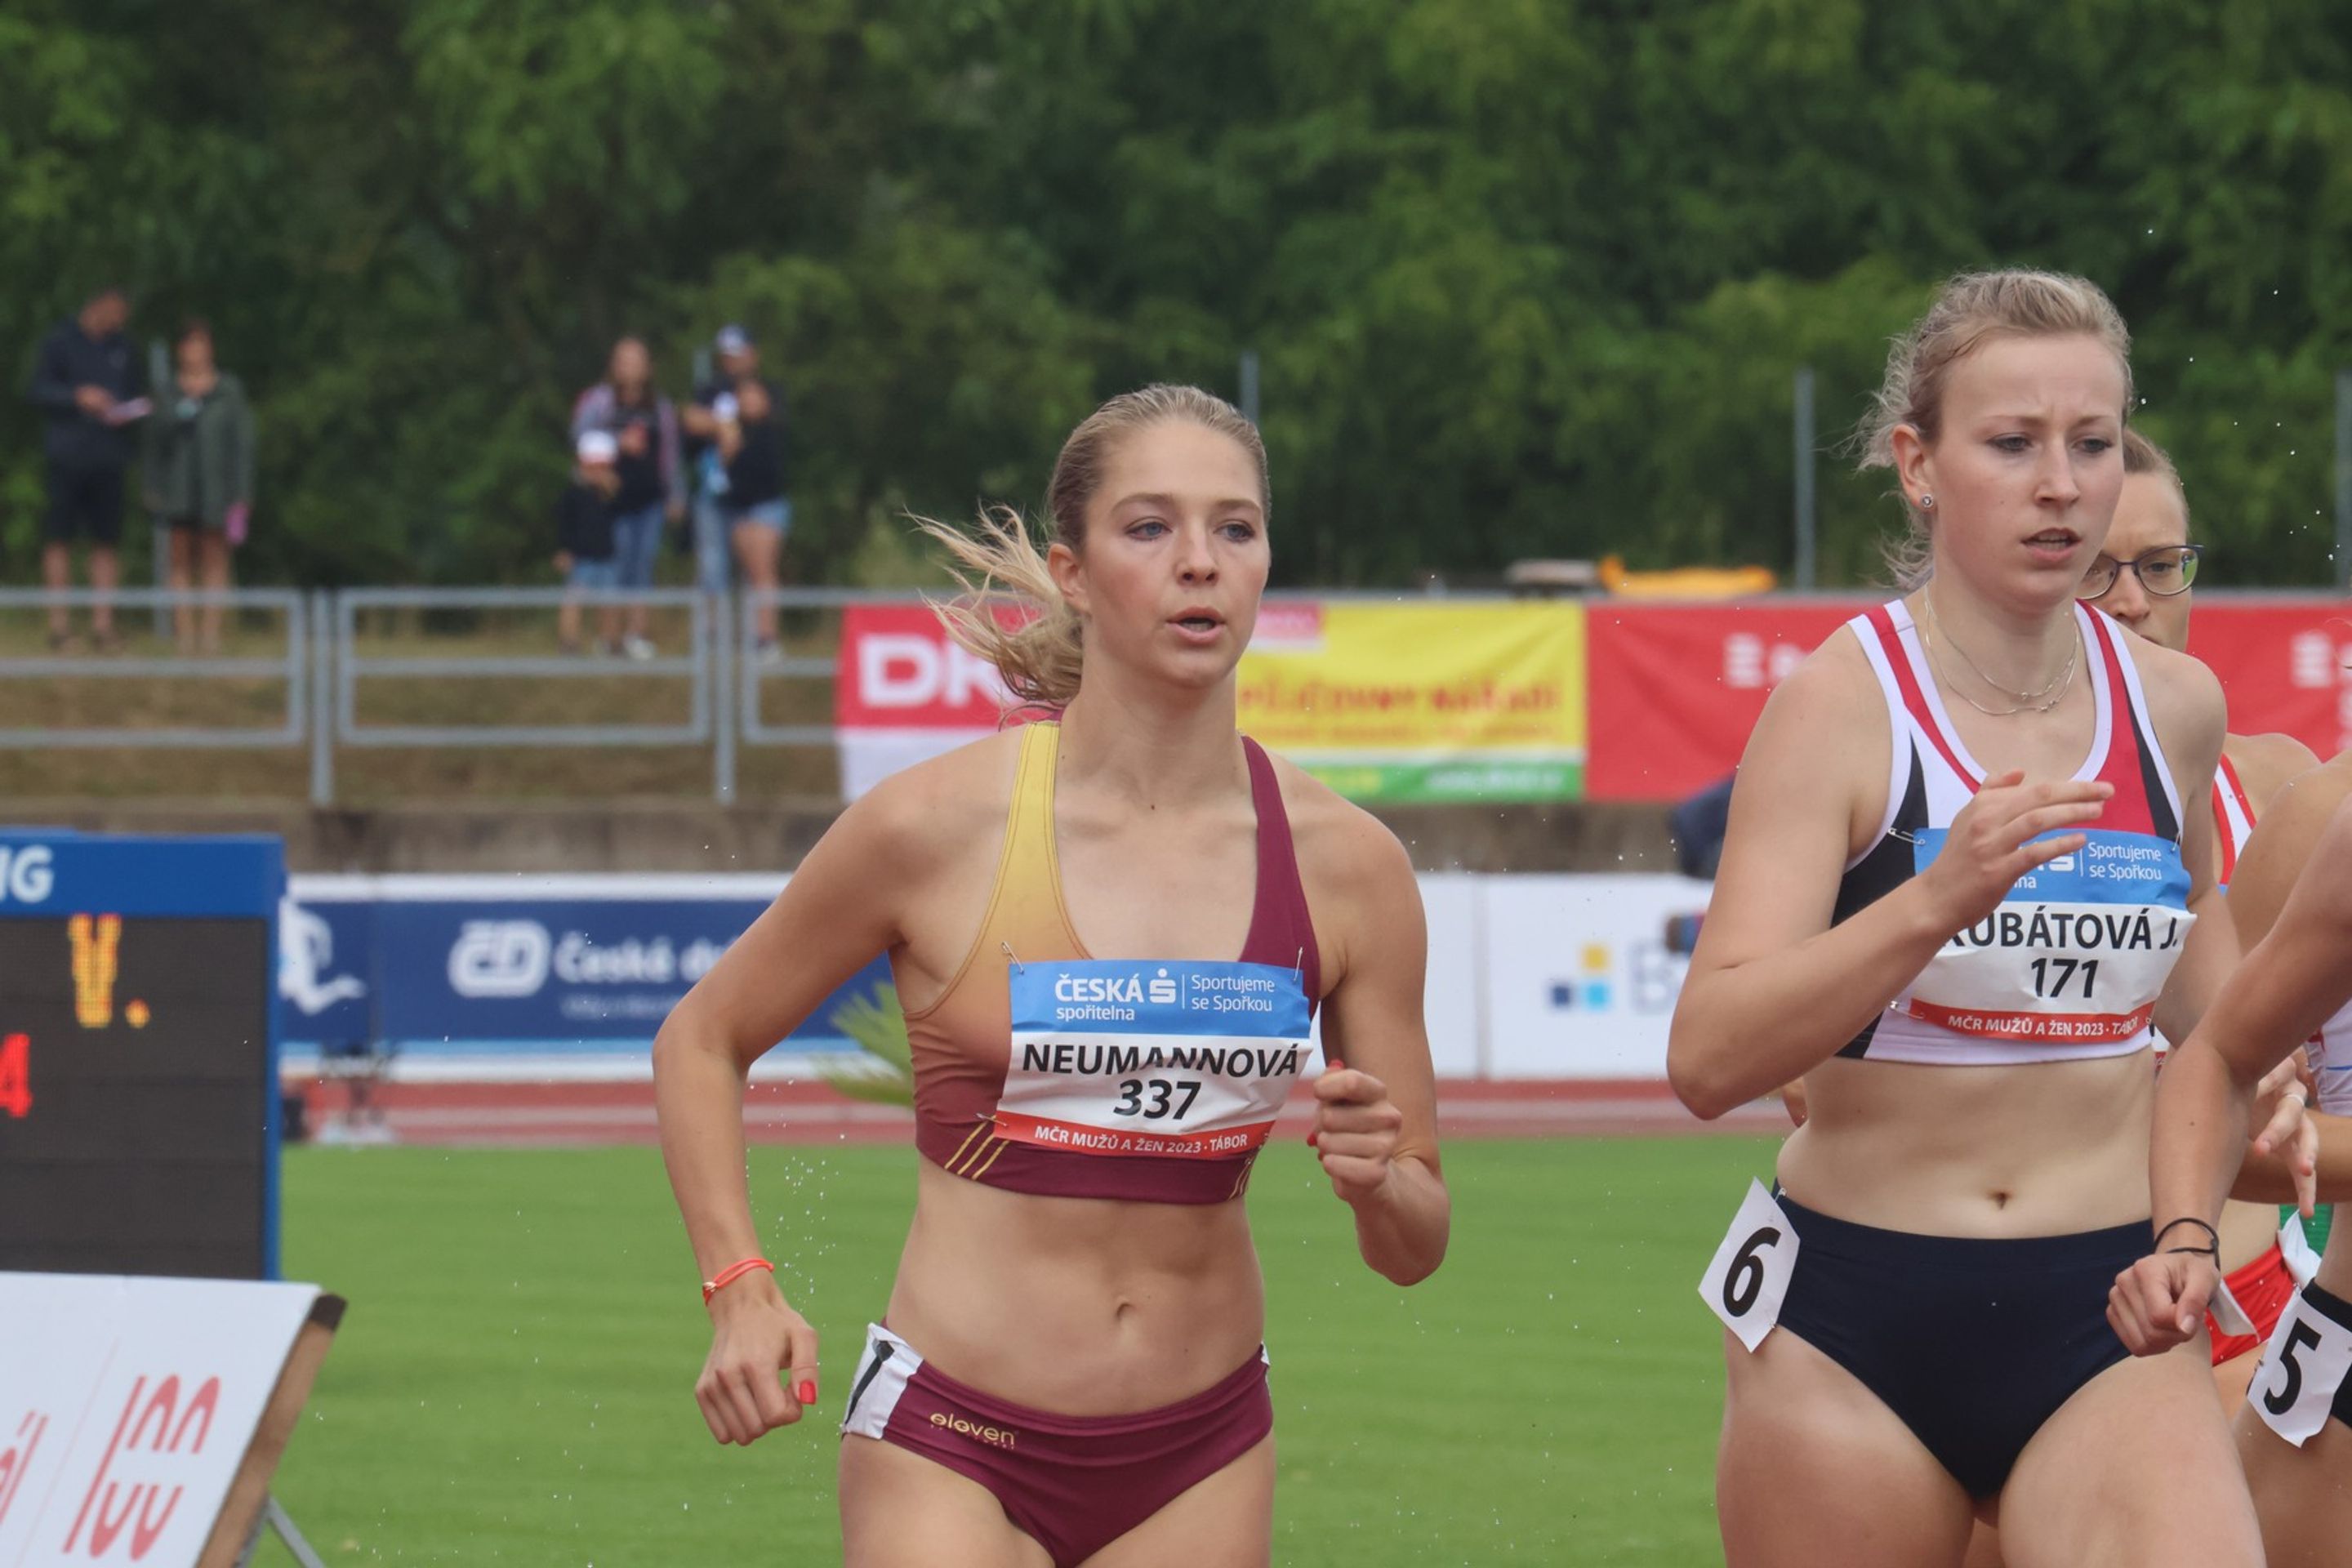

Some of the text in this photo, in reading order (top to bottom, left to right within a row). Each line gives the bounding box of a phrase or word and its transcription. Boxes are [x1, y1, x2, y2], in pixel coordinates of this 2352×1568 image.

[2088, 842, 2161, 862] Sportujeme
[2090, 863, 2162, 881] se Spořkou
[1055, 973, 1144, 1003] ČESKÁ
[1192, 974, 1275, 994] Sportujeme
[2030, 958, 2100, 999] 171
[1056, 1004, 1135, 1022] spořitelna
[1192, 995, 1272, 1013] se Spořkou
[1948, 1014, 1982, 1031] MČR
[1985, 1018, 2033, 1034] MUŽŮ
[2035, 1022, 2045, 1035] A
[2048, 1019, 2072, 1036] ŽEN
[2075, 1022, 2104, 1036] 2023
[1022, 1043, 1299, 1078] NEUMANNOVÁ
[1113, 1079, 1202, 1120] 337
[1035, 1125, 1249, 1154] MČR MUŽŮ A ŽEN 2023 TÁBOR
[1723, 1227, 1782, 1317] 6
[2263, 1317, 2322, 1415] 5
[930, 1413, 1014, 1446] eleven
